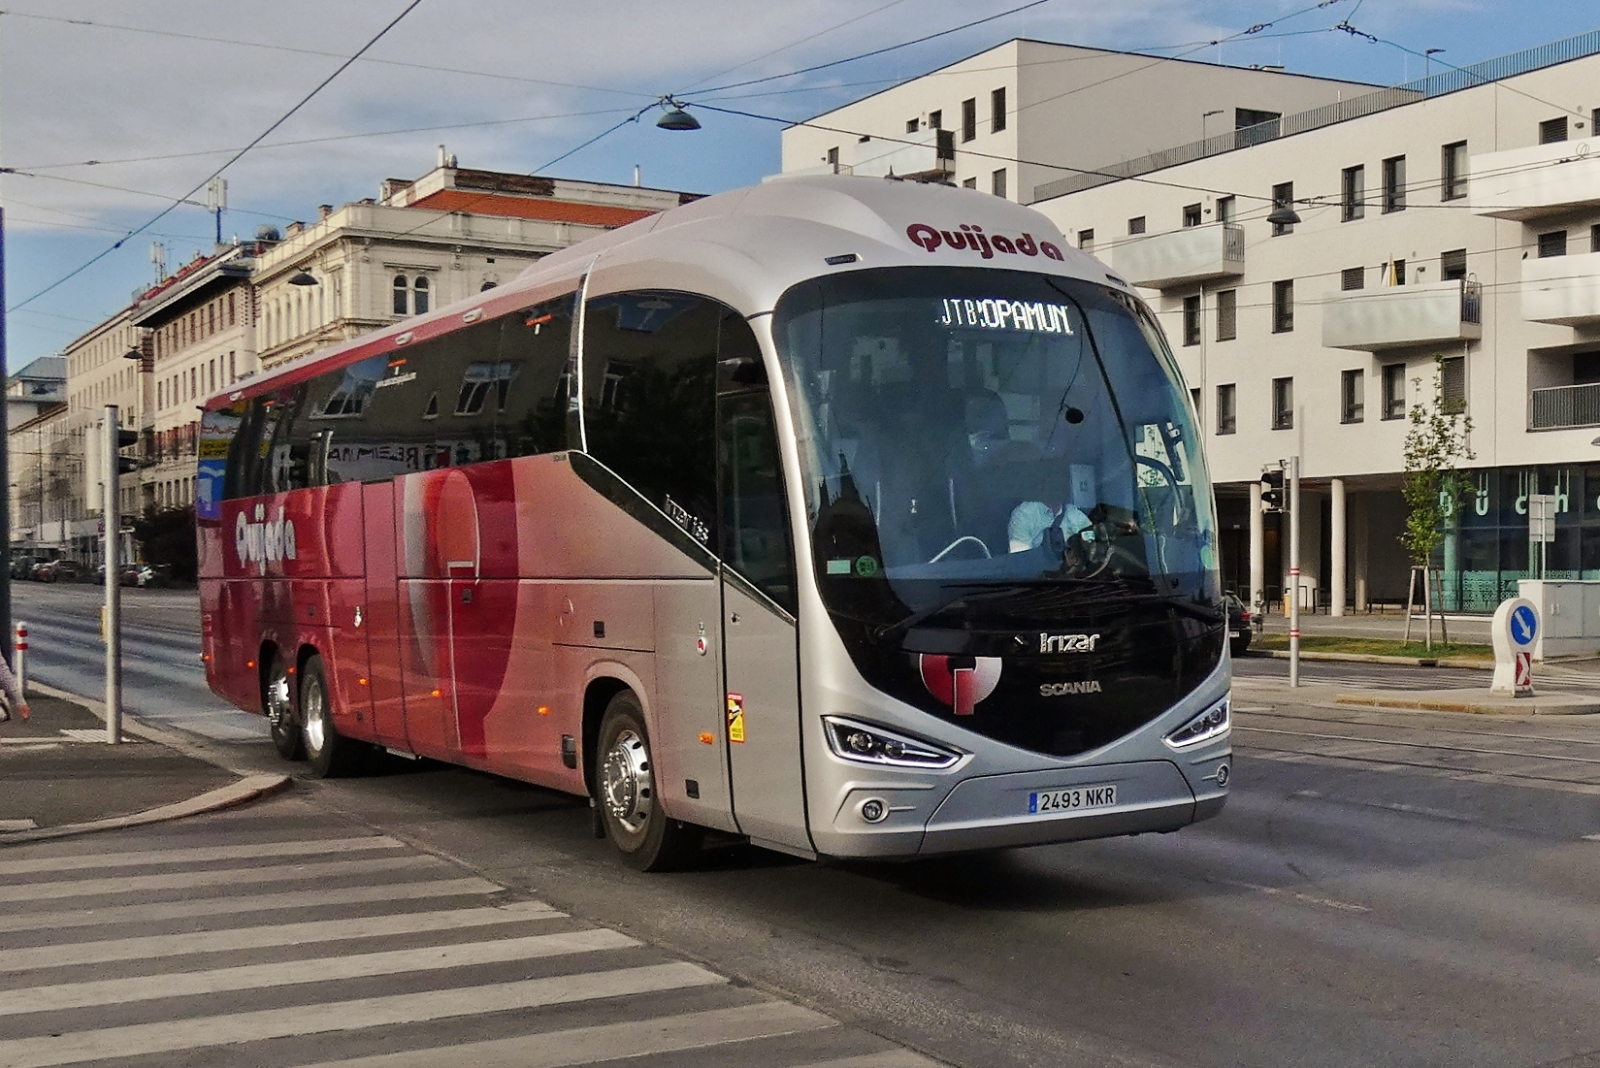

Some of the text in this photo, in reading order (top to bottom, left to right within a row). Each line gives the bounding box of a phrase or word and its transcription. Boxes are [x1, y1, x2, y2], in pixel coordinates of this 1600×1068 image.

[906, 223, 1065, 261] Quijada
[1439, 485, 1600, 517] Büch
[236, 503, 296, 576] Quijada
[1040, 680, 1102, 697] SCANIA
[1041, 787, 1114, 810] 2493 NKR
